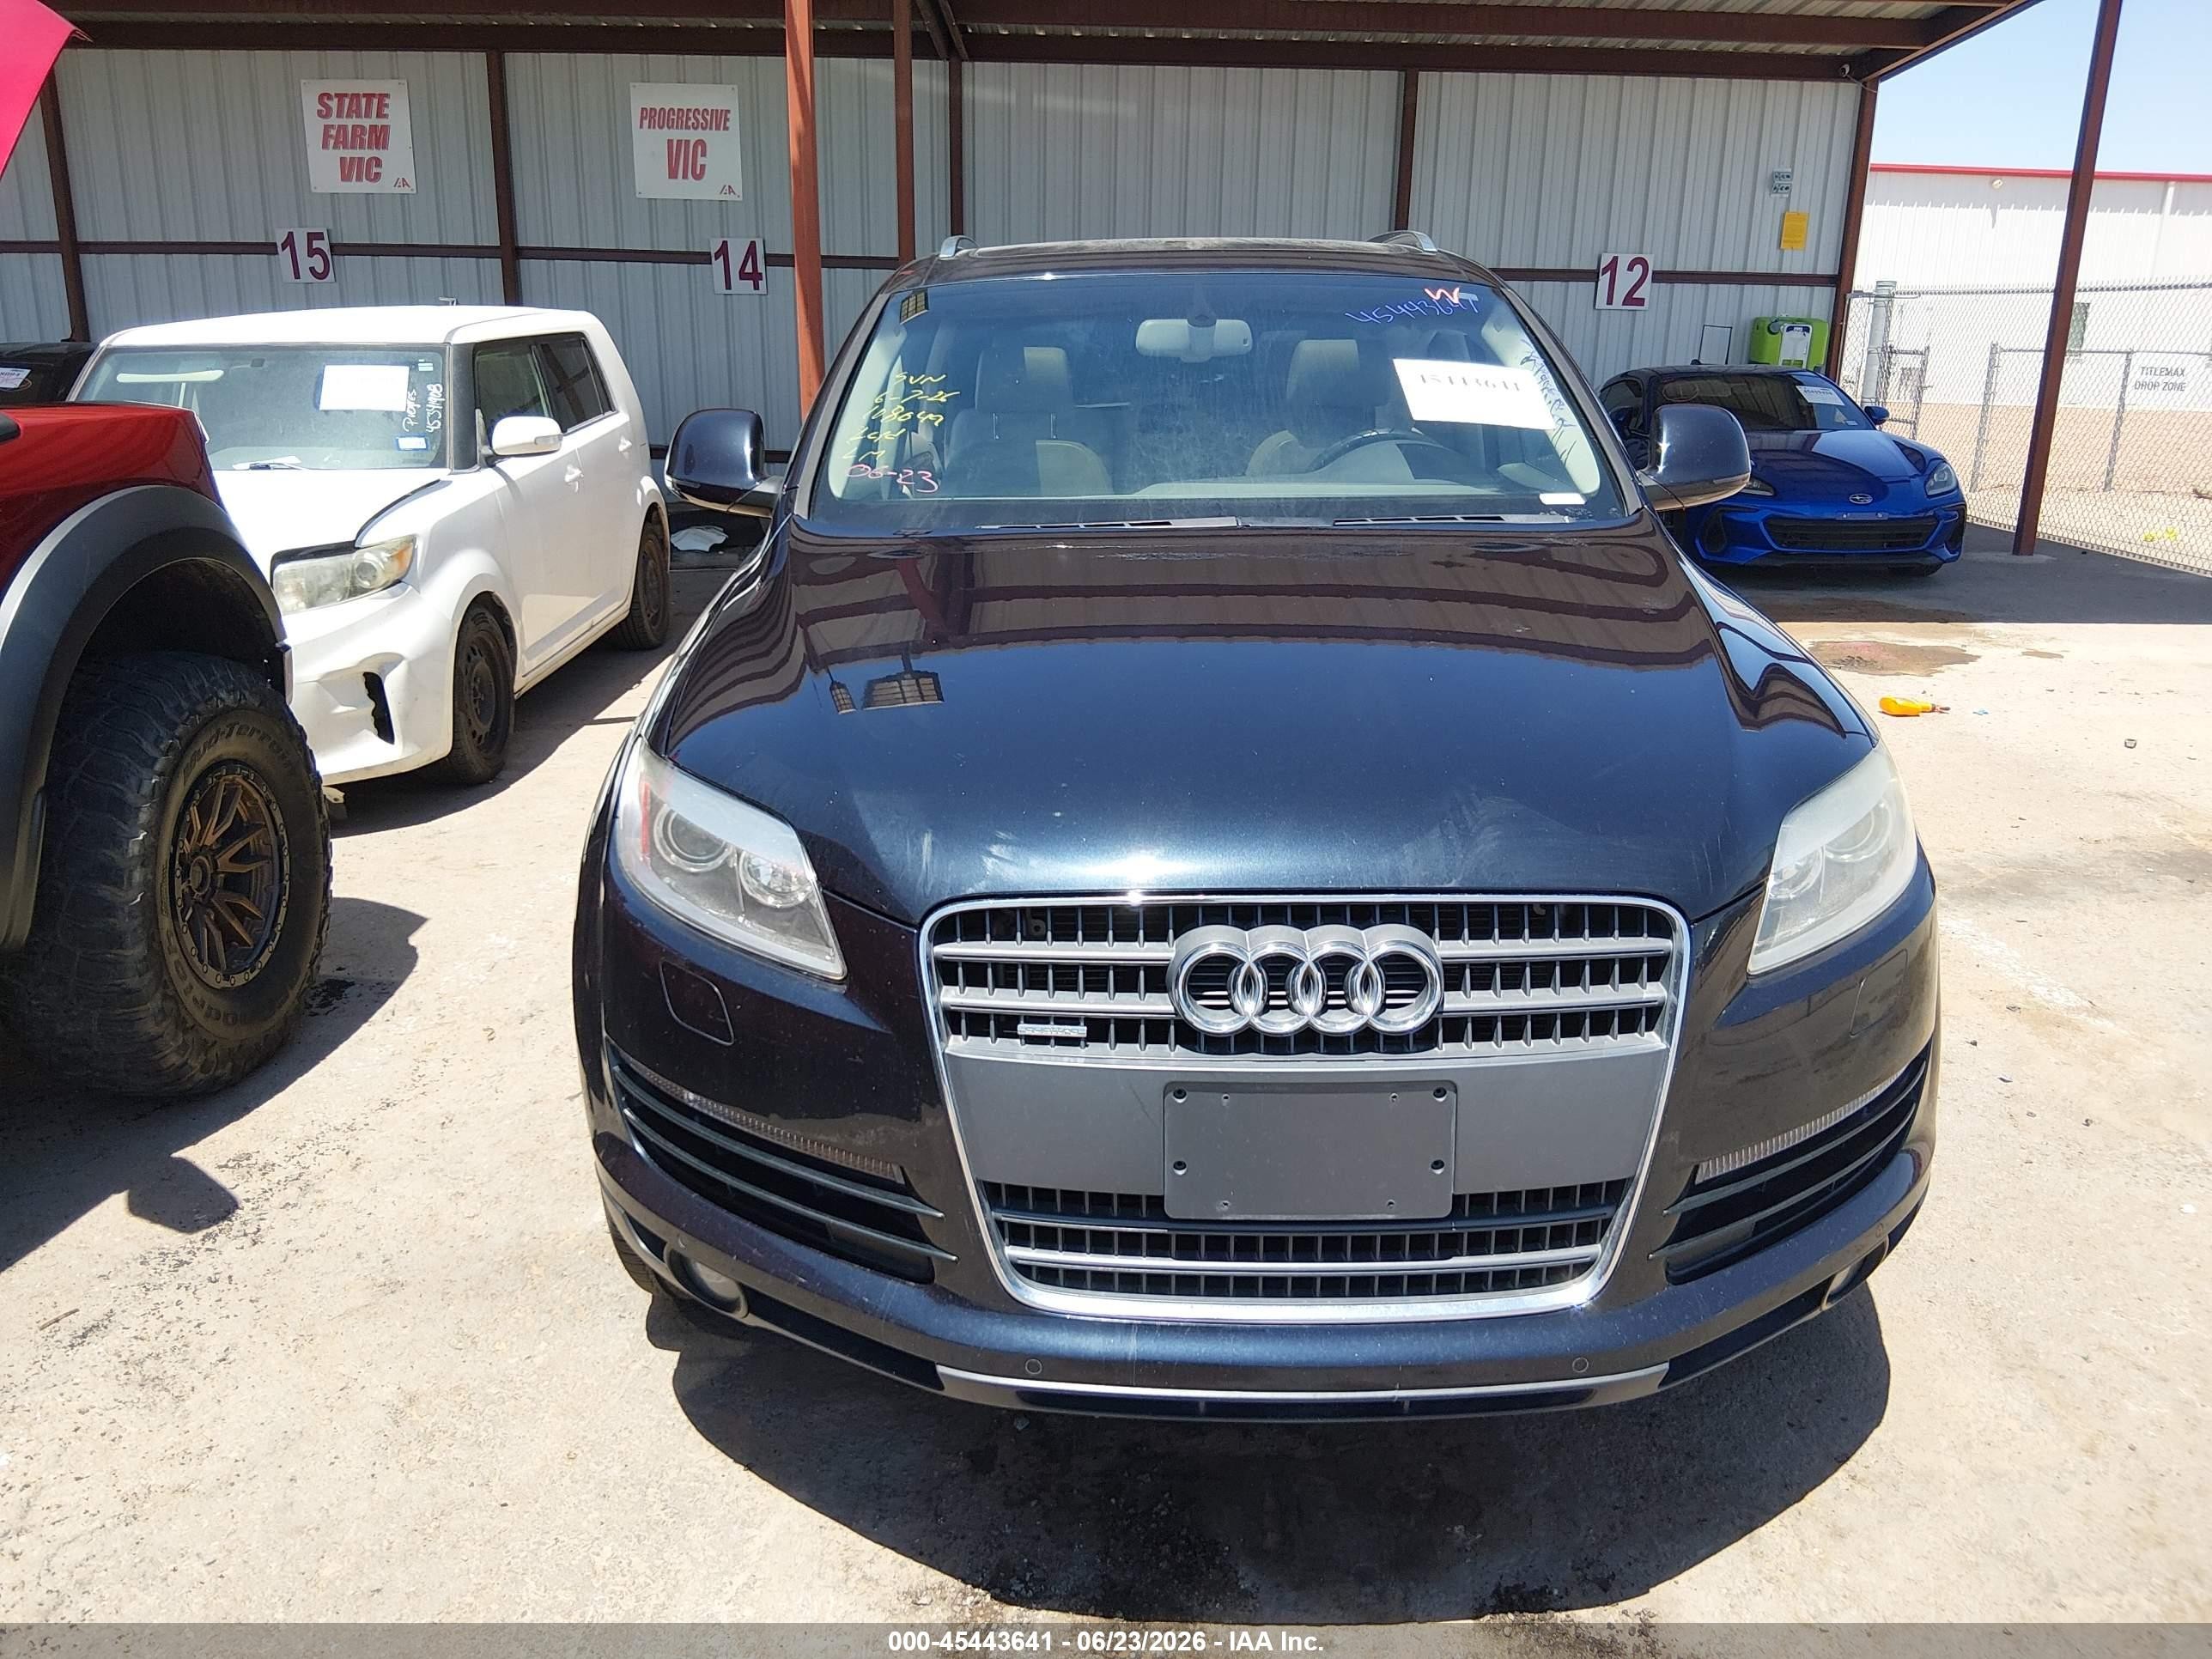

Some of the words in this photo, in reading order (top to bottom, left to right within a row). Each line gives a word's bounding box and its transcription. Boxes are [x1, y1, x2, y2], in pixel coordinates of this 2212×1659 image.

[317, 92, 391, 119] STATE
[639, 106, 731, 131] PROGRESSIVE
[321, 124, 391, 150] FARM
[339, 155, 383, 183] VIC
[666, 138, 708, 181] VIC
[281, 231, 331, 280] 15
[714, 240, 763, 291] 14
[1601, 255, 1650, 307] 12
[2140, 366, 2186, 377] TITLEMAX
[2134, 380, 2160, 391] DROP
[2162, 381, 2187, 392] ZONE
[846, 464, 939, 494] 06-23
